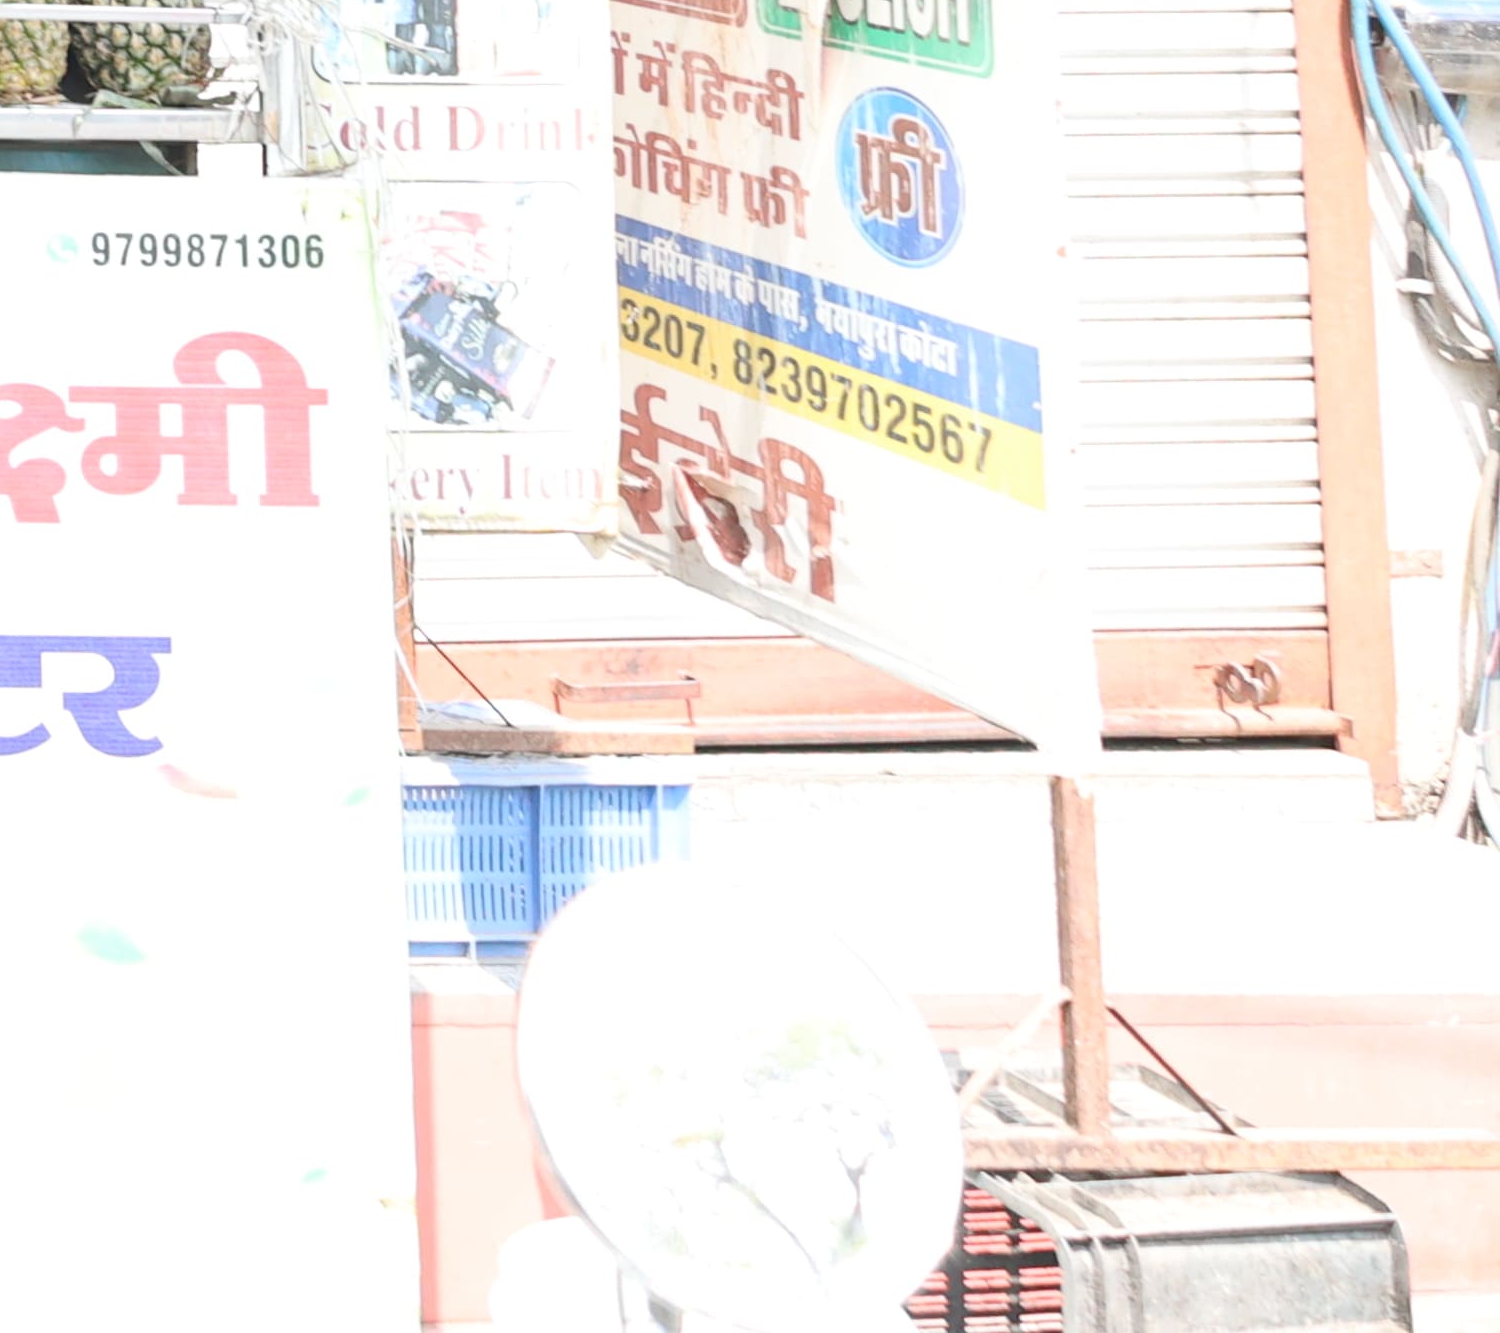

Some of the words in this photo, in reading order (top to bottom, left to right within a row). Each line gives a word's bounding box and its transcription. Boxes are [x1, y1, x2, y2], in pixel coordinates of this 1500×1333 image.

[682, 50, 805, 142] हिन्दी
[740, 165, 810, 240] फ्री
[854, 116, 943, 238] फ्री
[90, 229, 327, 273] 9799871306
[732, 337, 993, 474] 8239702567
